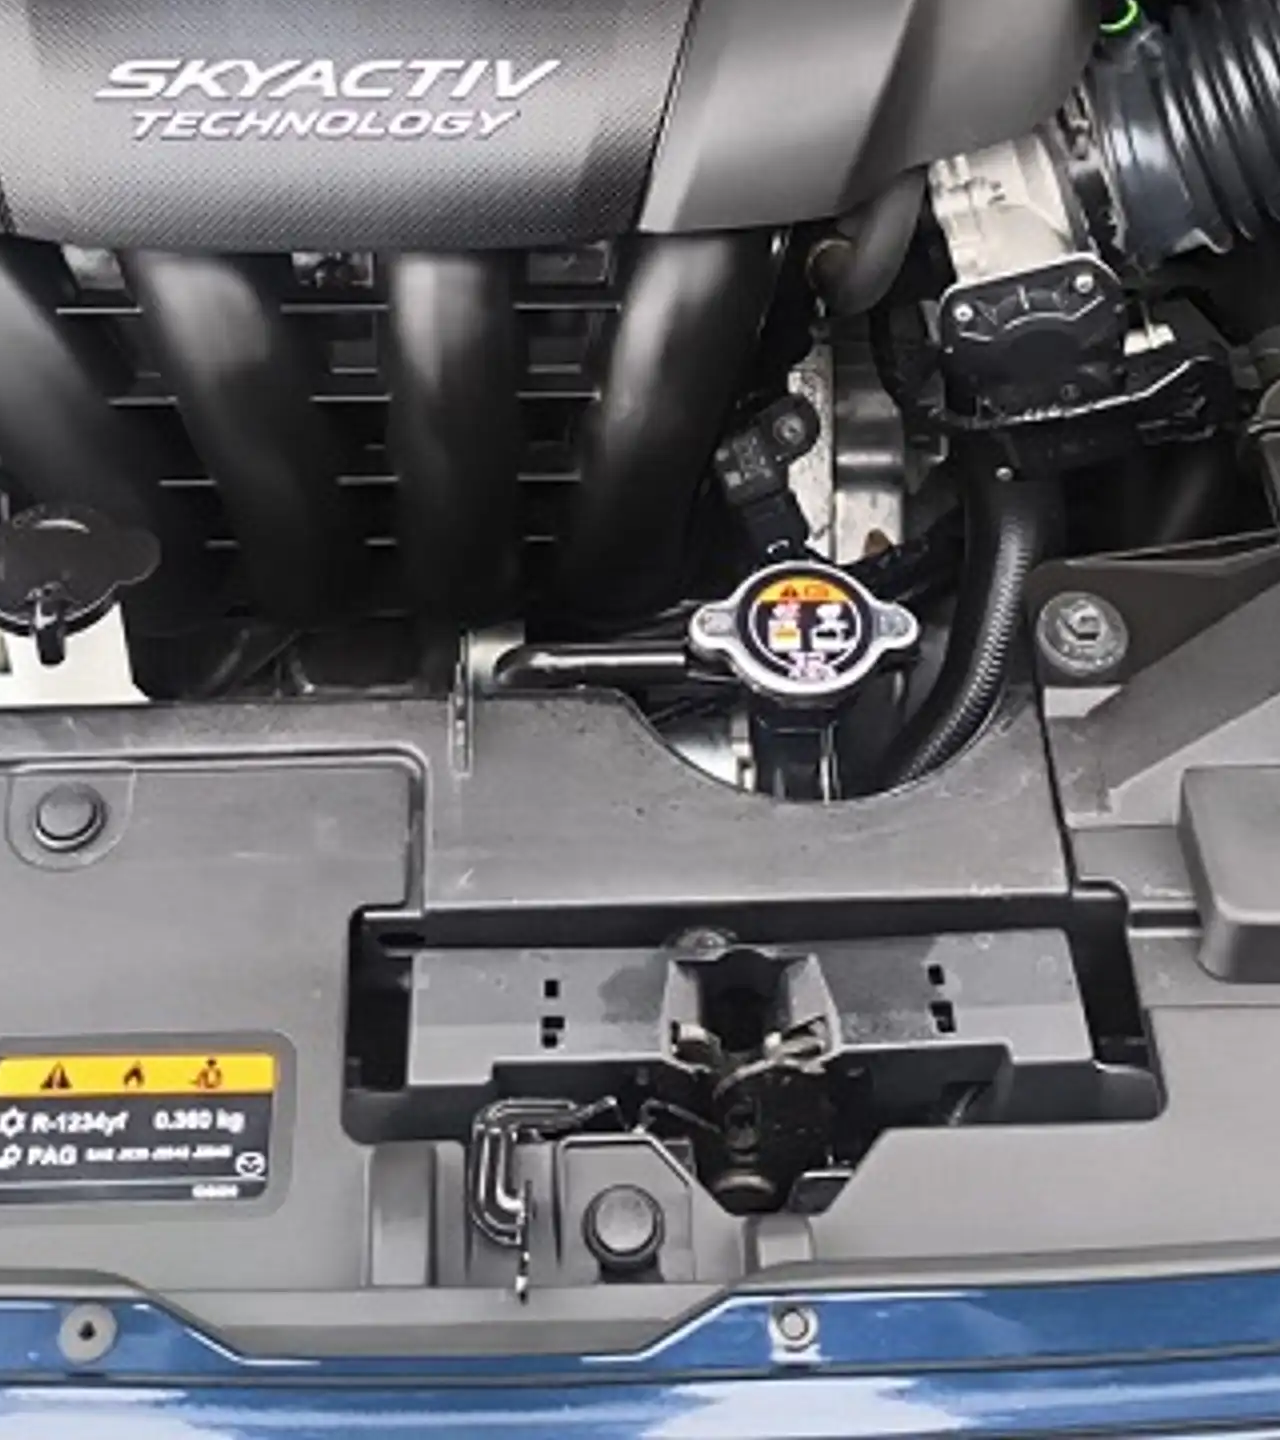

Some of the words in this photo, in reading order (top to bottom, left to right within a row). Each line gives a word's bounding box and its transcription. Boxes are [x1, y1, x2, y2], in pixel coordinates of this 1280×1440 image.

[95, 59, 561, 99] SKYACTIV
[132, 109, 518, 138] TECHNOLOGY
[27, 1144, 77, 1166] PAG
